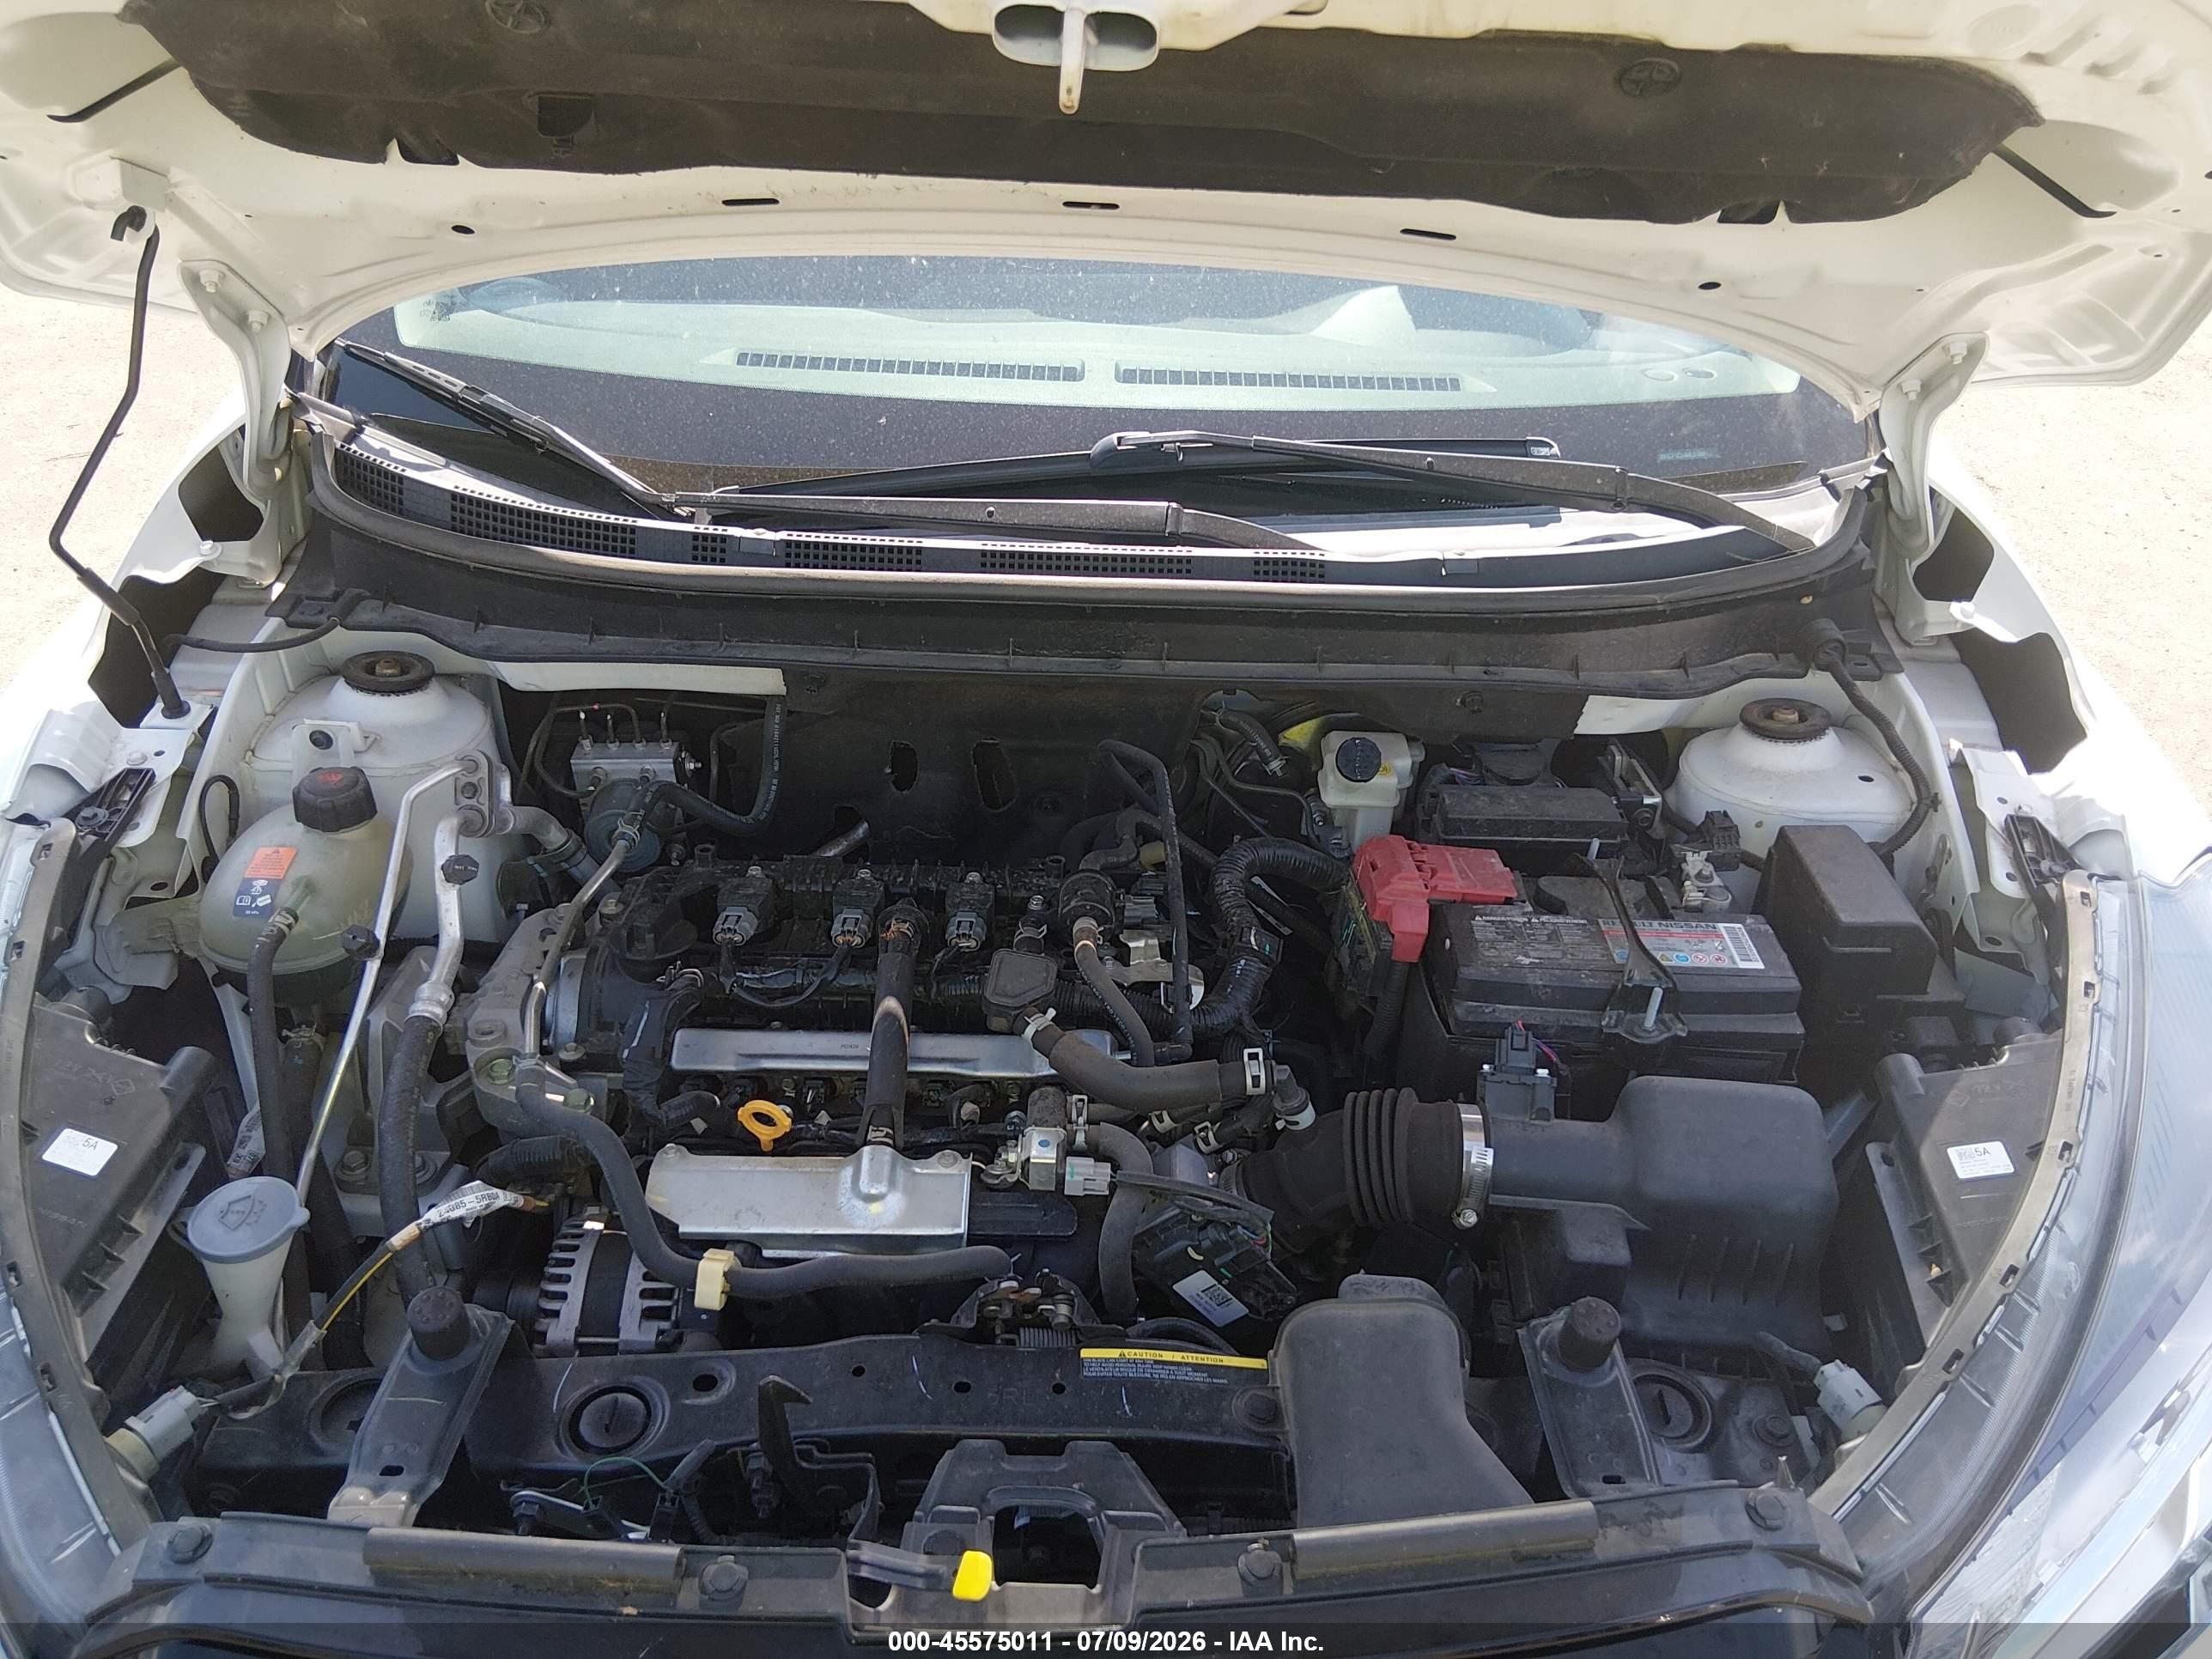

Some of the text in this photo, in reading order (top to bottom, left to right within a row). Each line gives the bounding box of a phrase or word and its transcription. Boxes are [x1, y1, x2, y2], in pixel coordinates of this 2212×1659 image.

[1602, 920, 1717, 930] REULT NISSAN
[82, 1137, 100, 1152] 5A
[1974, 1146, 1991, 1157] 5A
[1181, 1354, 1224, 1363] ATTENTION
